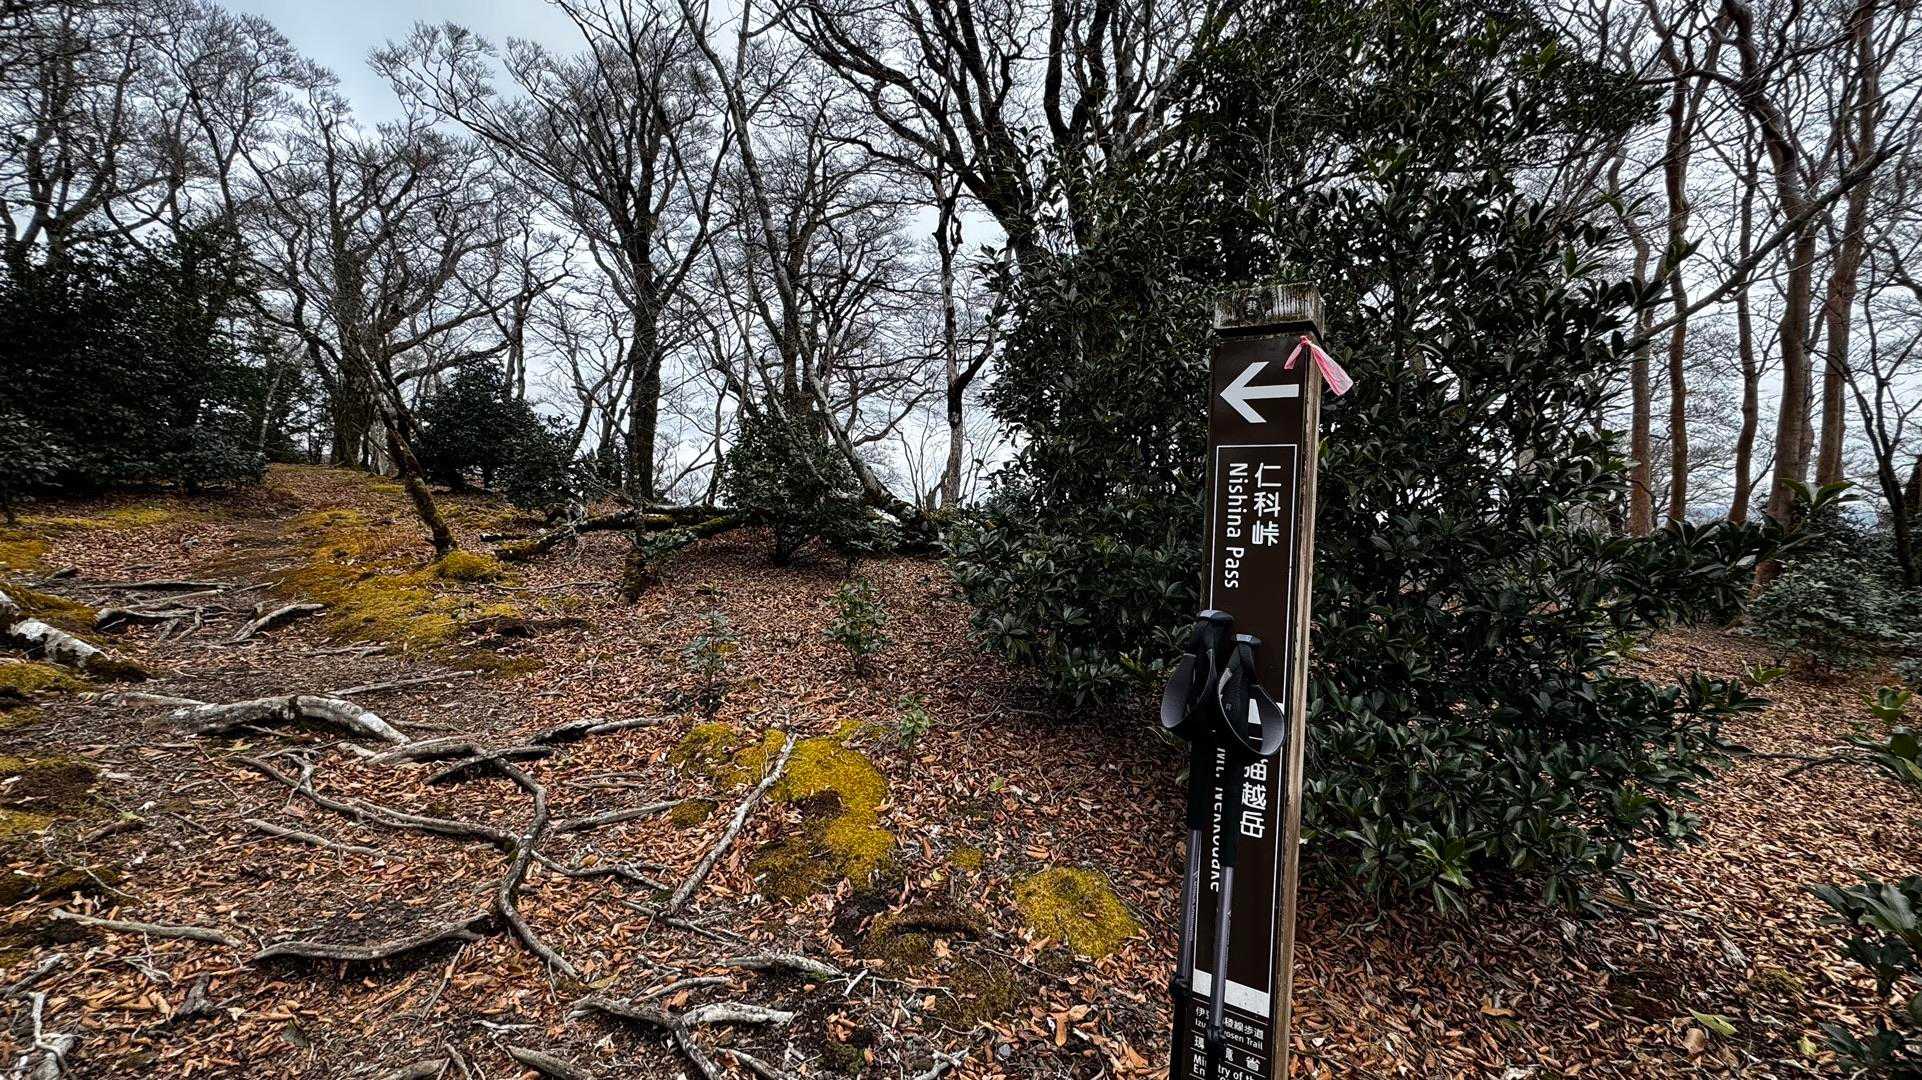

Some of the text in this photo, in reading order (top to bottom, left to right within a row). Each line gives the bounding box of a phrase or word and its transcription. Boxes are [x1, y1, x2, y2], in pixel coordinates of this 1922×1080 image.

[1224, 462, 1249, 589] Nishina Pass
[1252, 462, 1282, 547] 仁科峠
[1246, 1037, 1263, 1051] Trail
[1233, 1072, 1243, 1080] of
